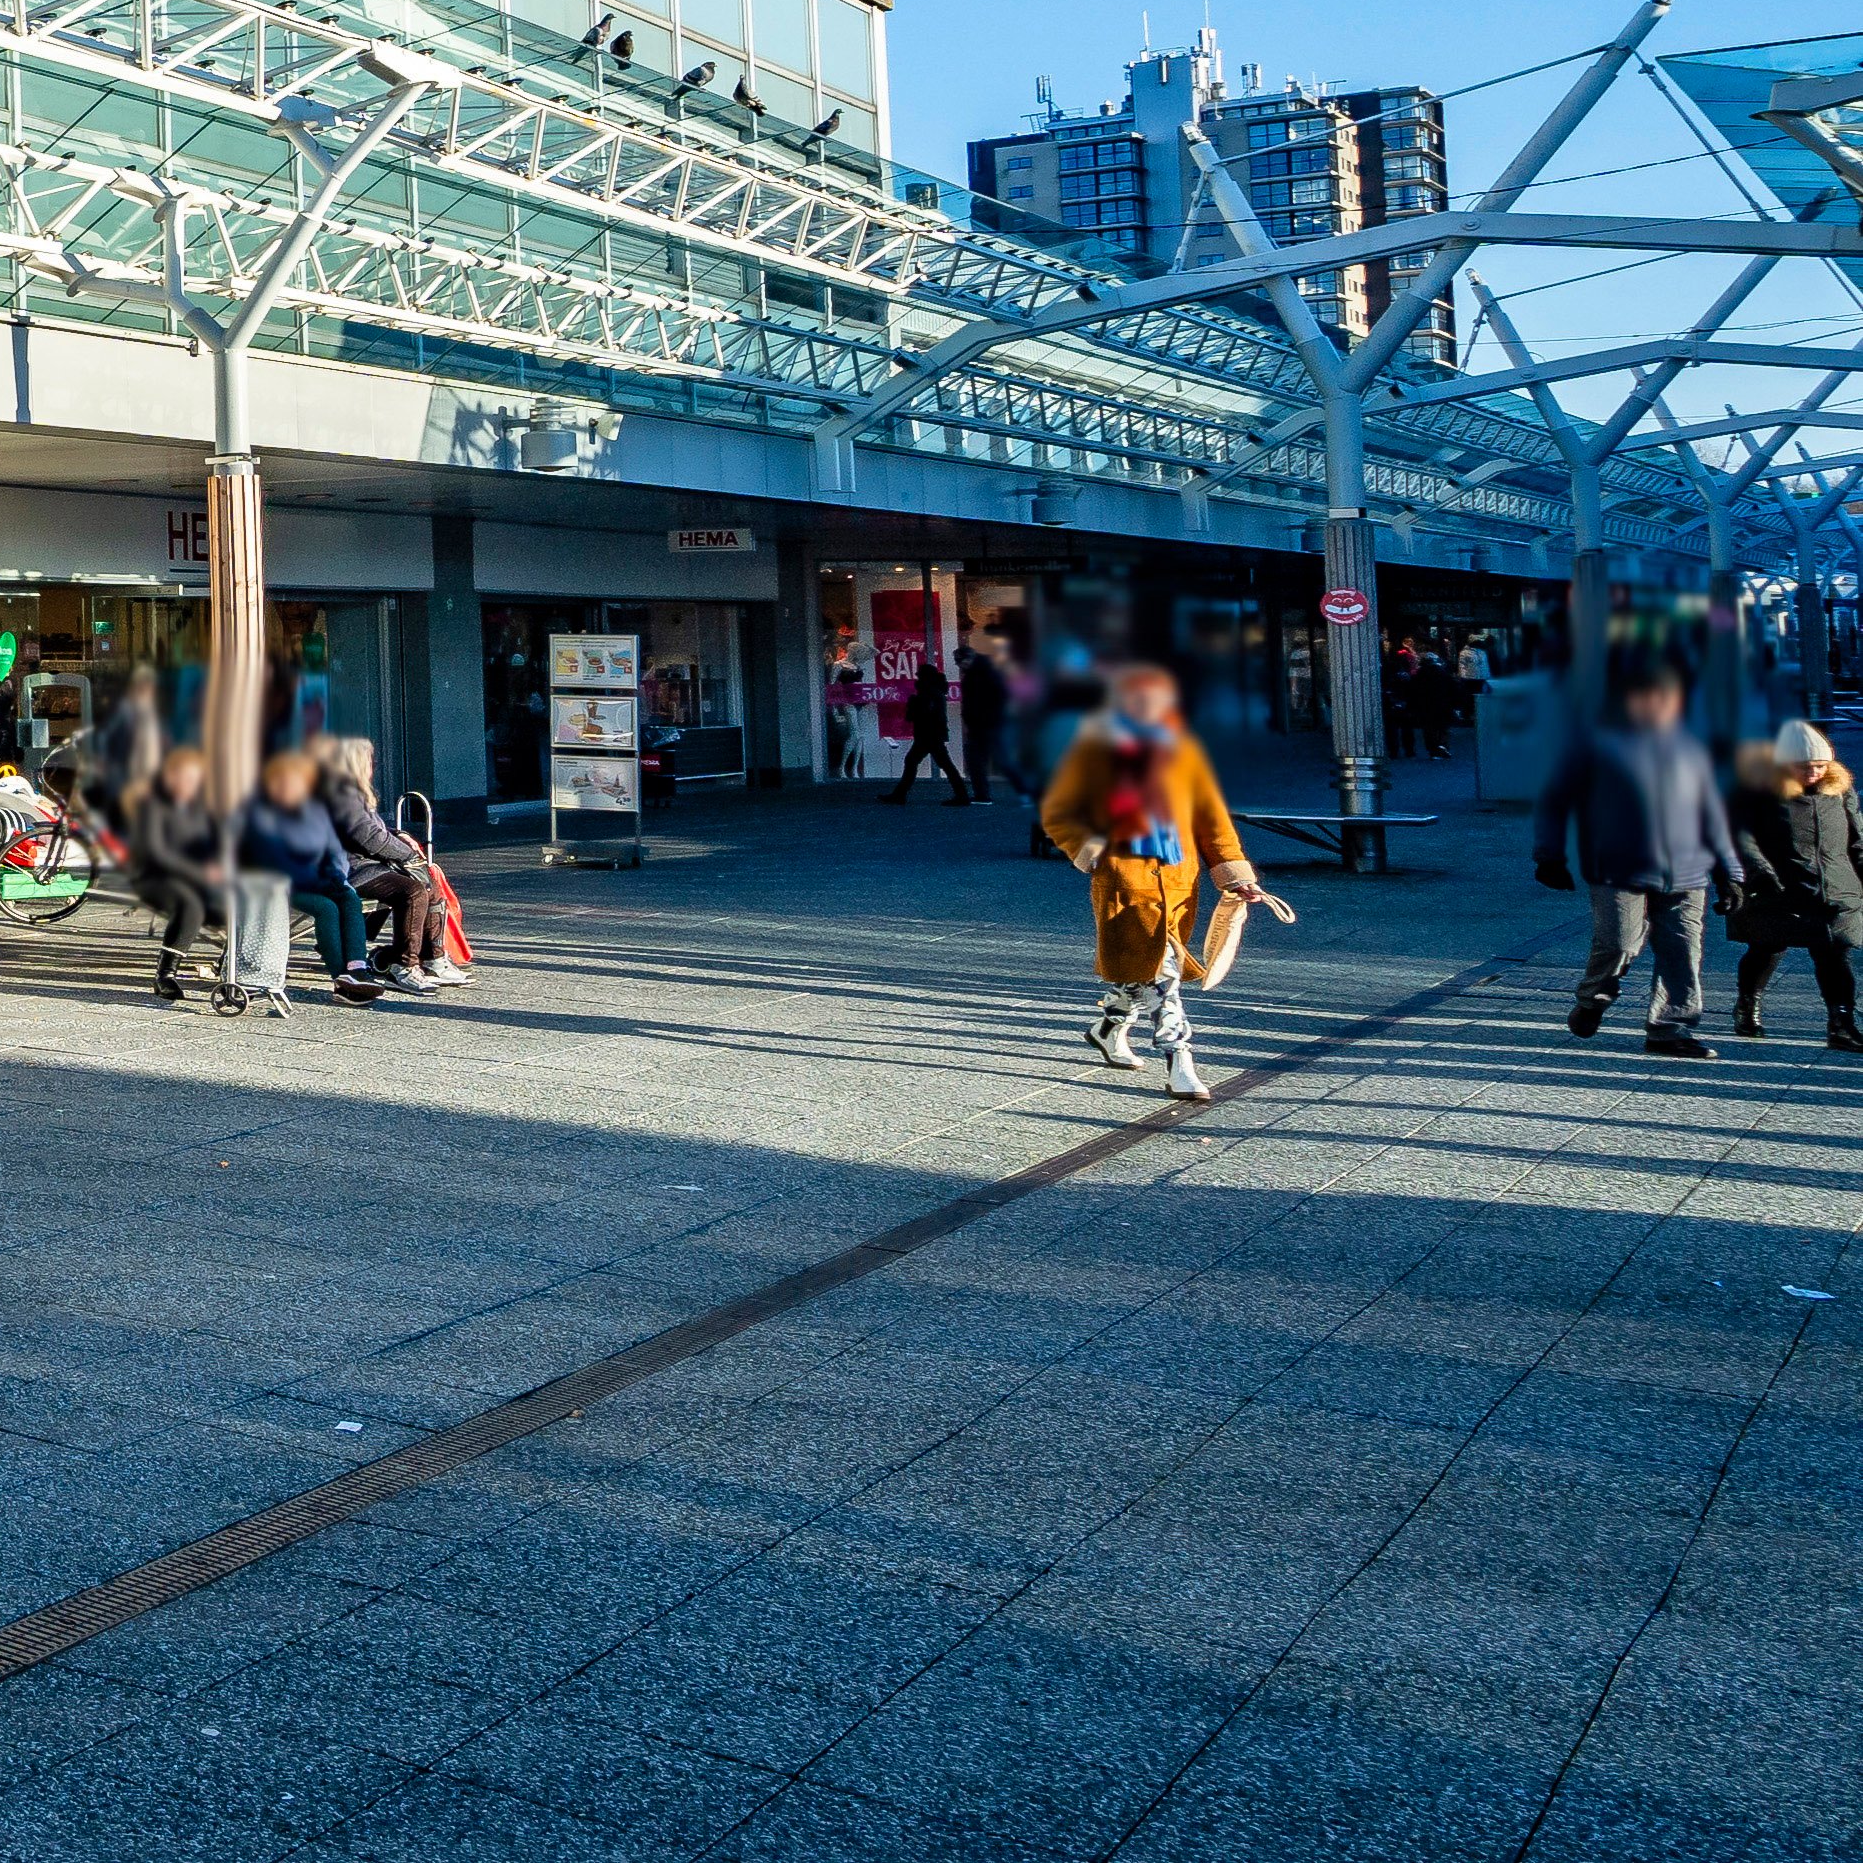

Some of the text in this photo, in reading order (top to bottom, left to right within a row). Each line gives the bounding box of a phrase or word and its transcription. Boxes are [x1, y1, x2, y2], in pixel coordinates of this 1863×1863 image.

[167, 511, 209, 561] HE
[678, 530, 738, 547] HEMA
[880, 651, 939, 680] SAL
[855, 685, 901, 701] -50%
